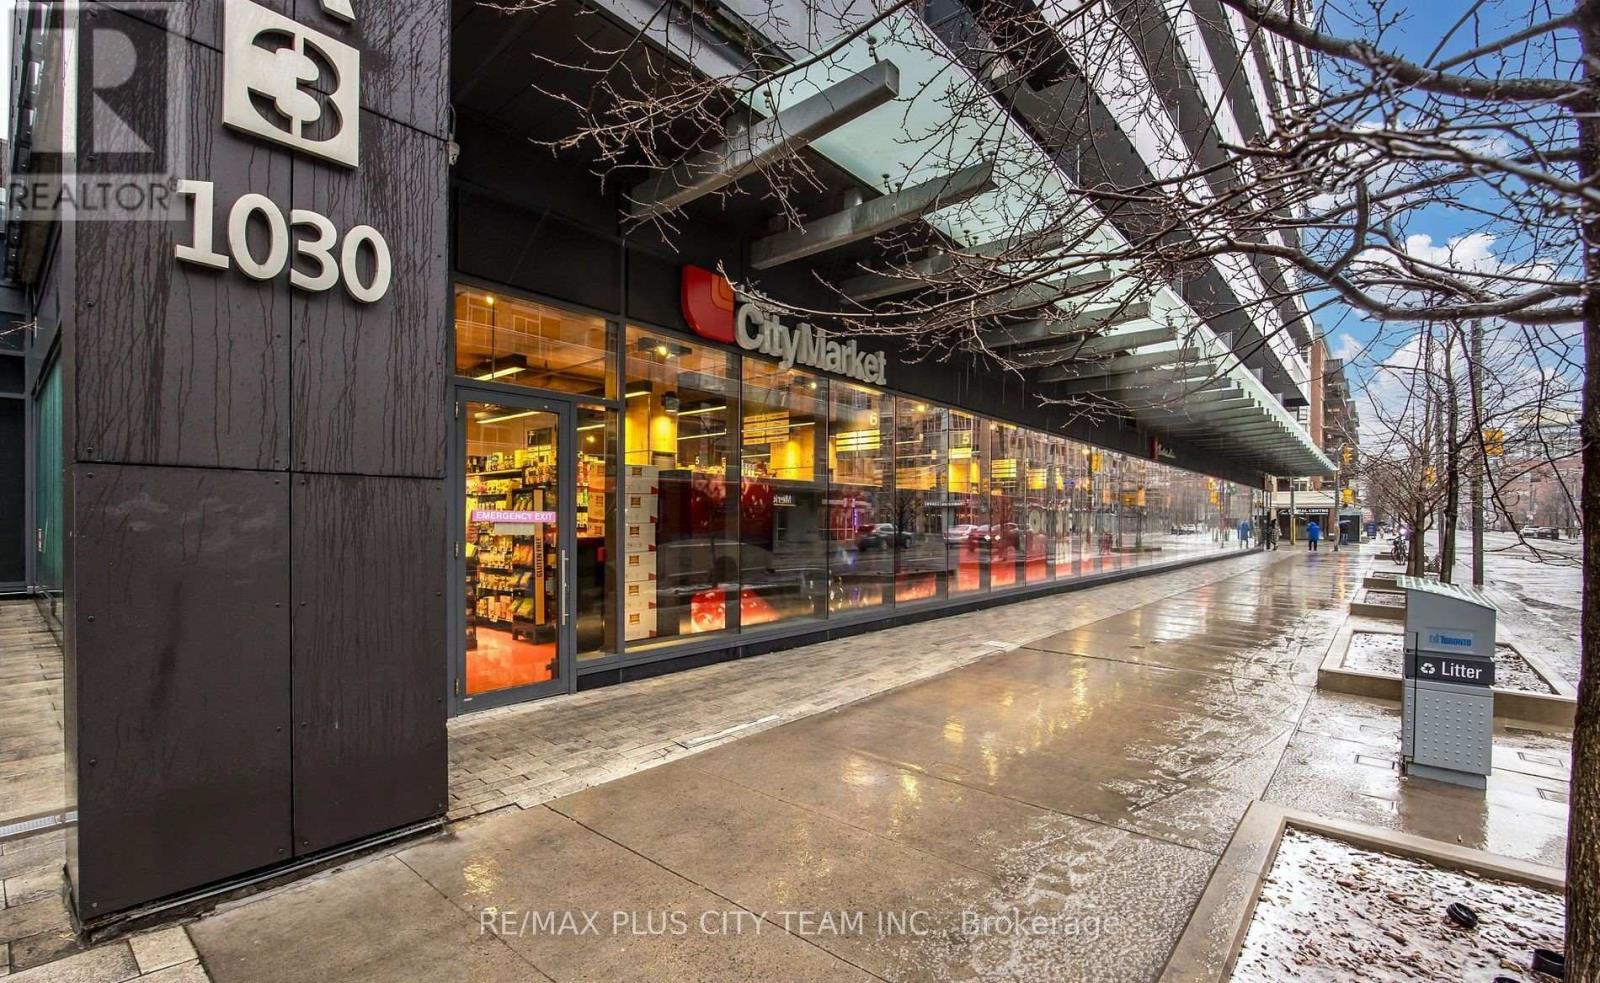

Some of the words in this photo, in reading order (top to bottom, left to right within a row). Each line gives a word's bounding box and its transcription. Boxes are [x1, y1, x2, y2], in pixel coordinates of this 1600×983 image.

[246, 27, 344, 142] 3
[174, 179, 392, 303] 1030
[869, 412, 878, 425] 6
[962, 433, 970, 445] 5
[476, 511, 531, 520] EMERGENCY
[535, 512, 553, 520] EXIT
[1441, 661, 1483, 679] Litter
